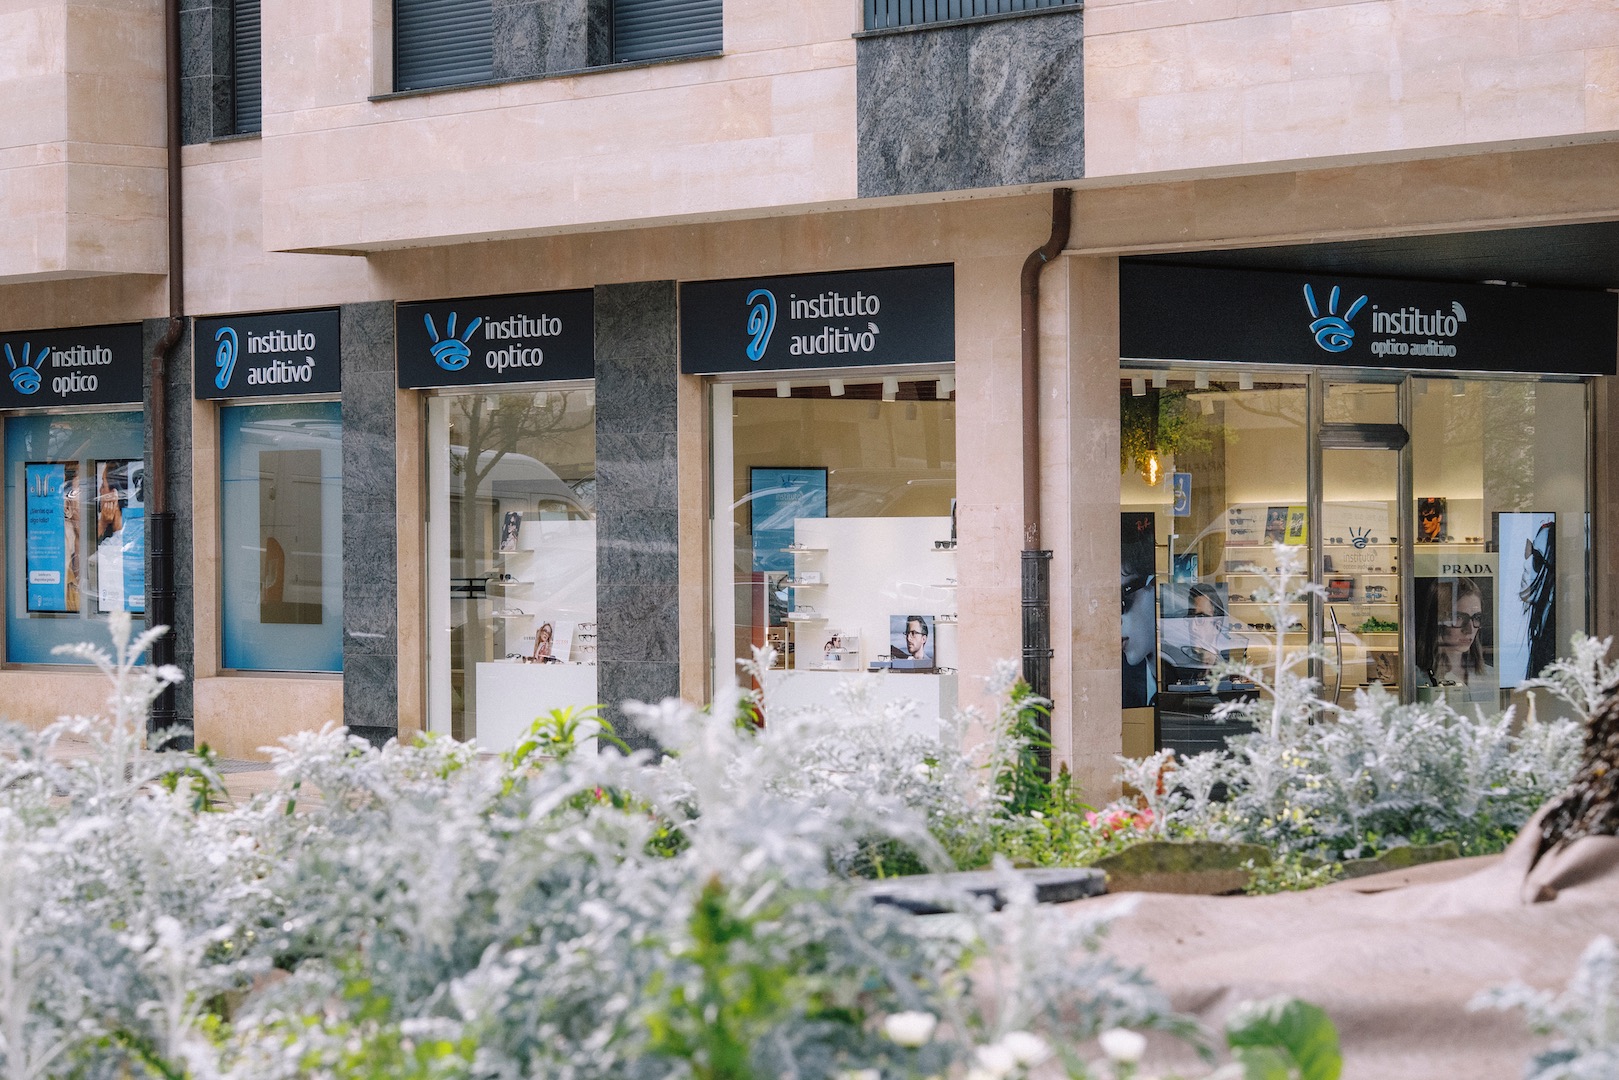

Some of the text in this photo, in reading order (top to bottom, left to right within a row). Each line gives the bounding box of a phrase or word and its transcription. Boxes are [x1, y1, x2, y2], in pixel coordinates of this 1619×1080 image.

[789, 290, 881, 321] instituto
[484, 313, 563, 341] instituto
[1372, 304, 1458, 337] instituto
[247, 329, 316, 354] instituto
[789, 325, 877, 357] auditivo
[1370, 338, 1457, 358] optico auditivo
[51, 345, 113, 368] instituto
[485, 343, 544, 374] optico
[52, 371, 98, 397] optico
[247, 360, 313, 385] auditivo
[1343, 552, 1375, 563] instituto
[1442, 564, 1493, 574] PRADA
